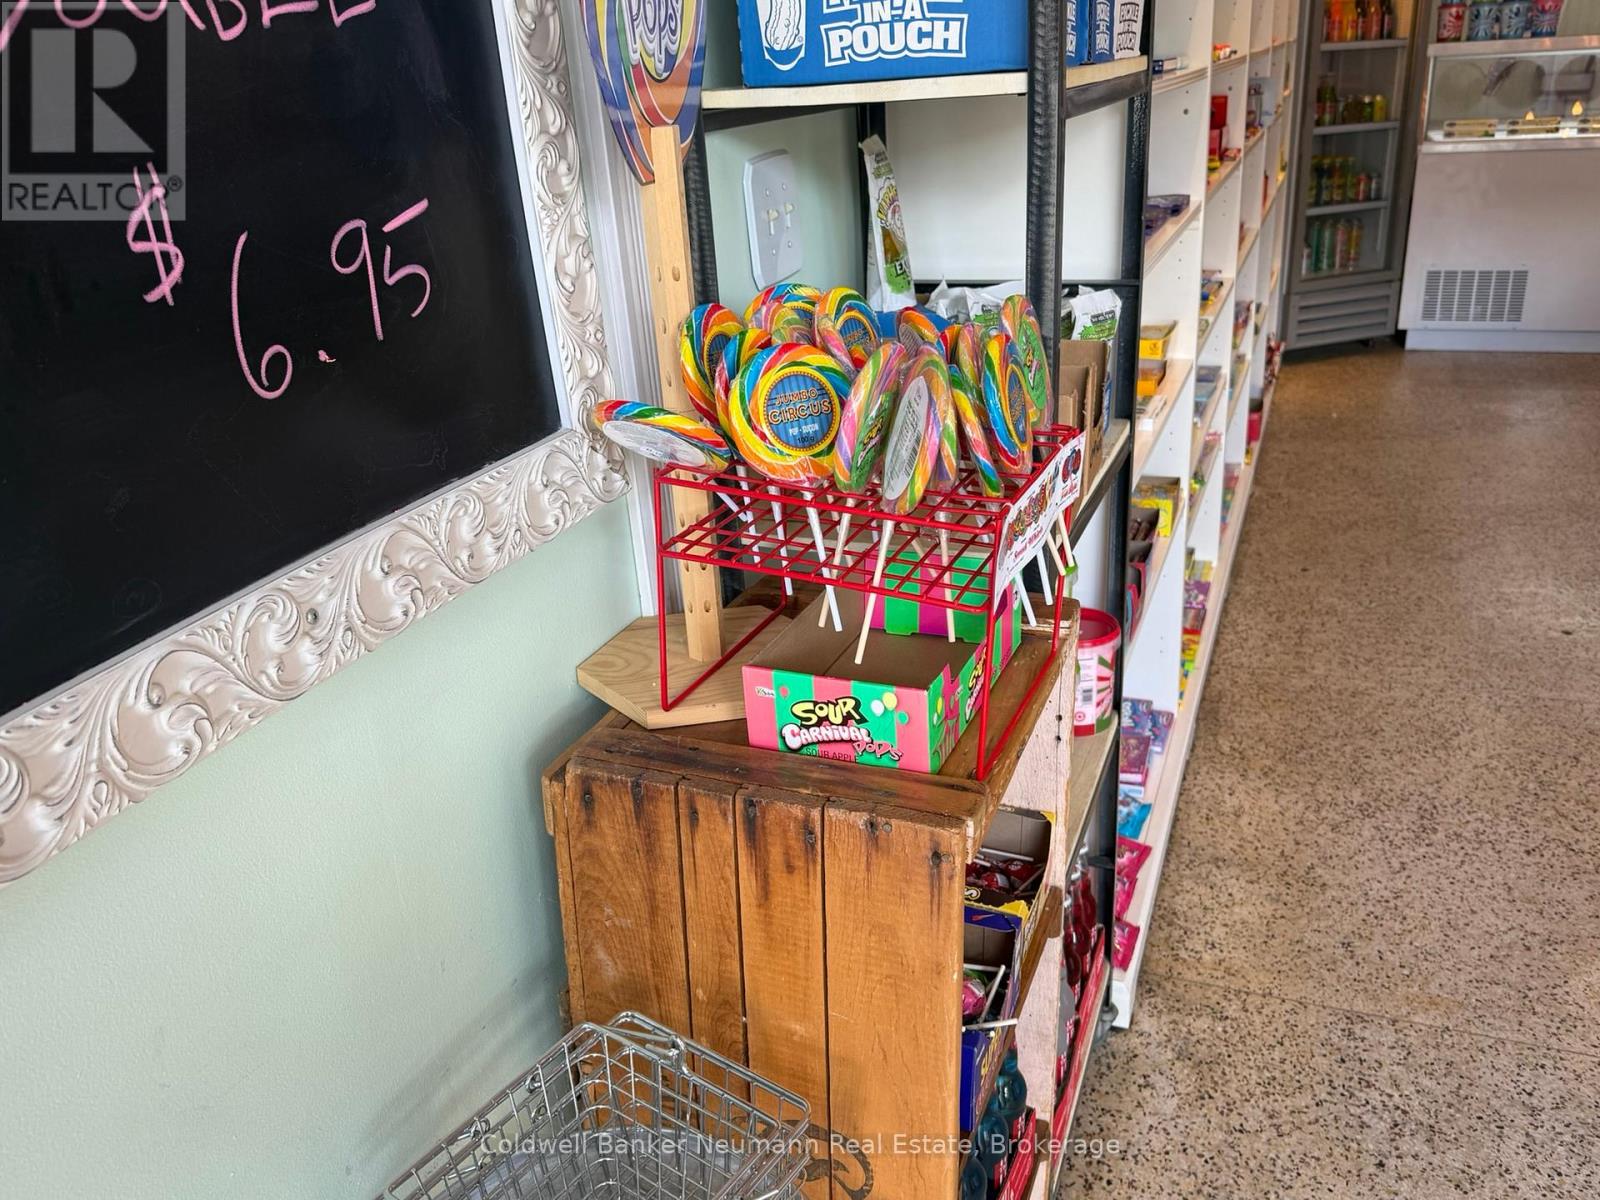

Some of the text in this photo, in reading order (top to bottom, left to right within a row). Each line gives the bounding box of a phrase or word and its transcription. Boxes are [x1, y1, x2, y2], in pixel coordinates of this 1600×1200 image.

[828, 20, 961, 59] POUCH
[775, 387, 819, 406] JUMBO
[768, 400, 832, 424] CIRCUS
[791, 697, 862, 726] SOUR
[782, 723, 873, 750] CARNIVAL
